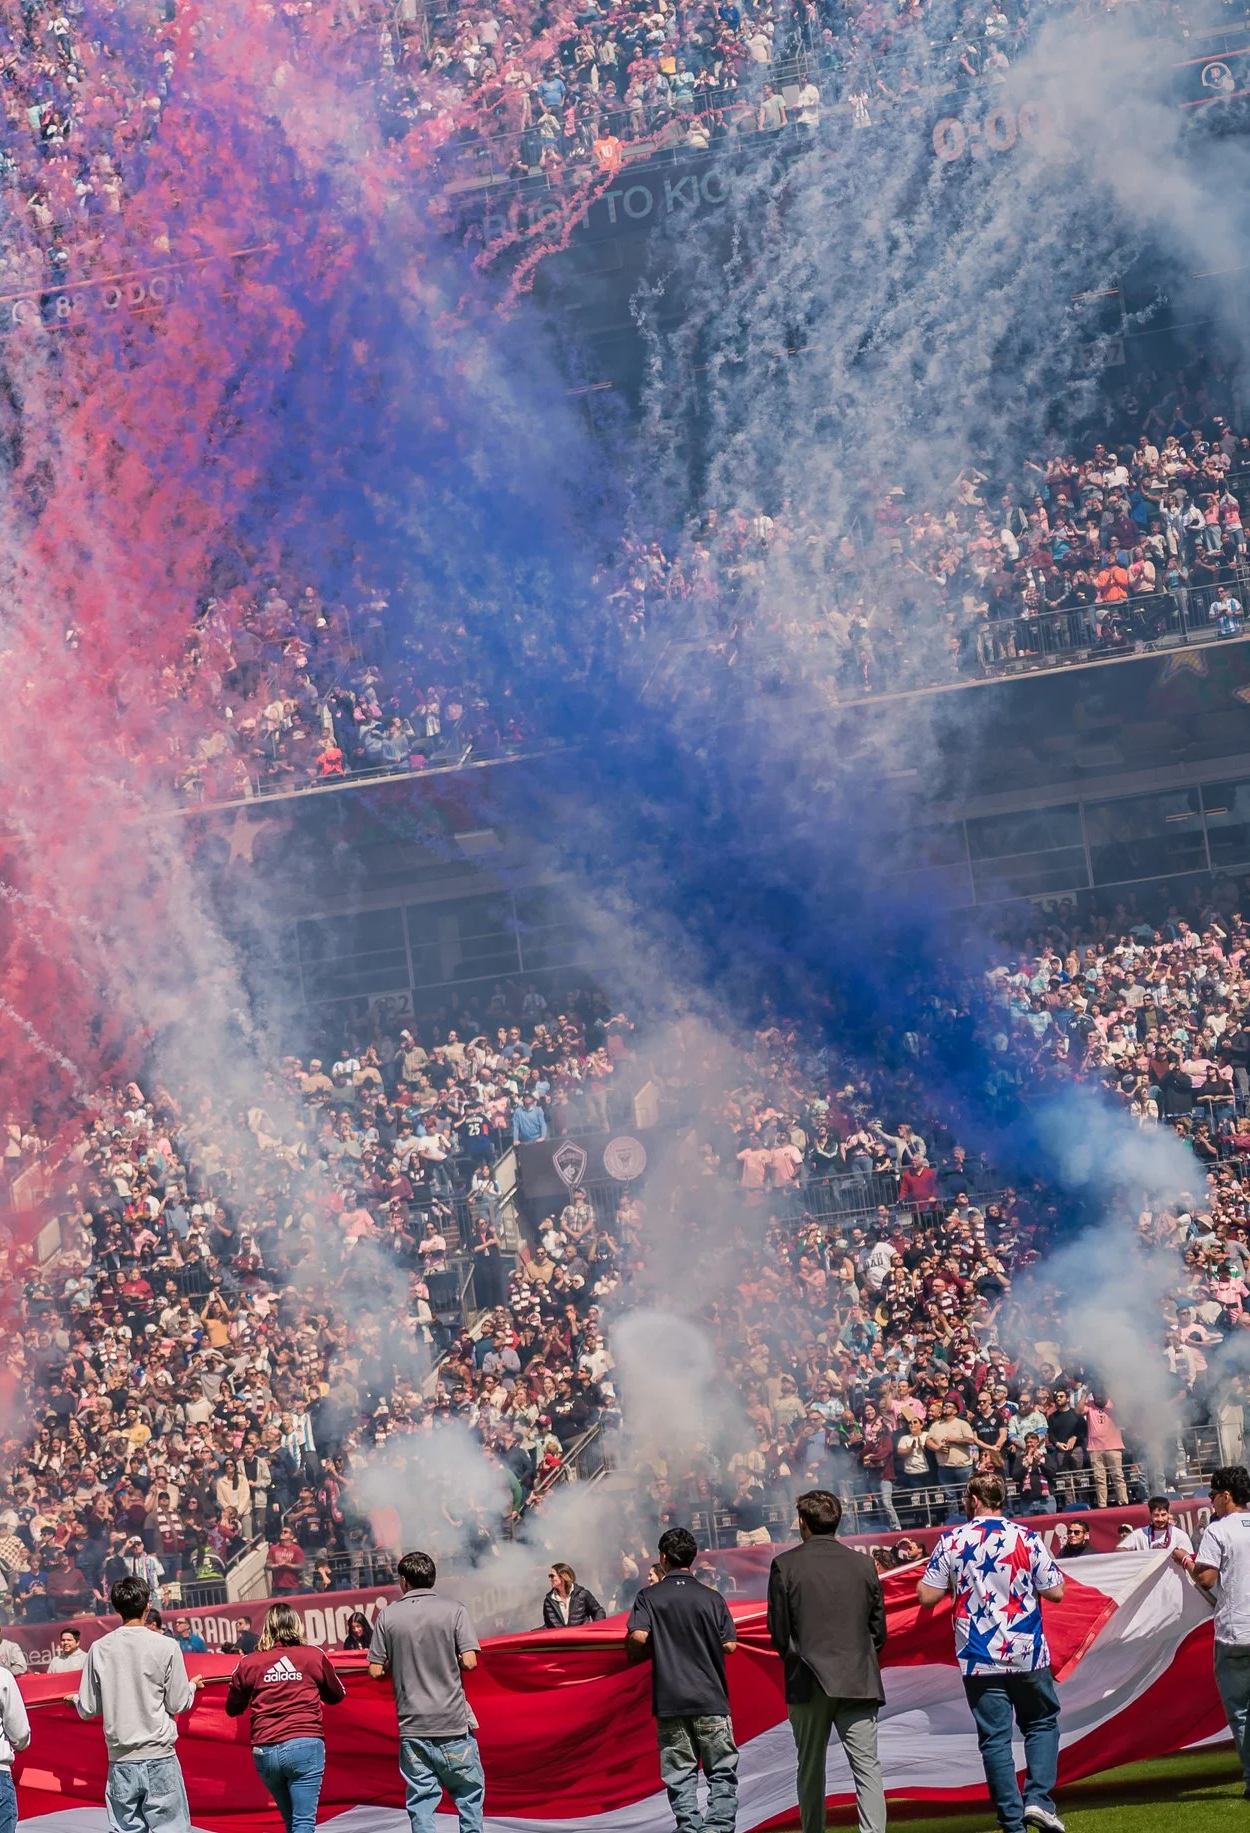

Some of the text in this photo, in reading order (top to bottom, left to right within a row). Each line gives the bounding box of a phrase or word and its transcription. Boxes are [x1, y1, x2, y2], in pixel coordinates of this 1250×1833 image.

[601, 184, 654, 224] TO
[468, 1123, 480, 1136] 25
[263, 1671, 303, 1683] adidas
